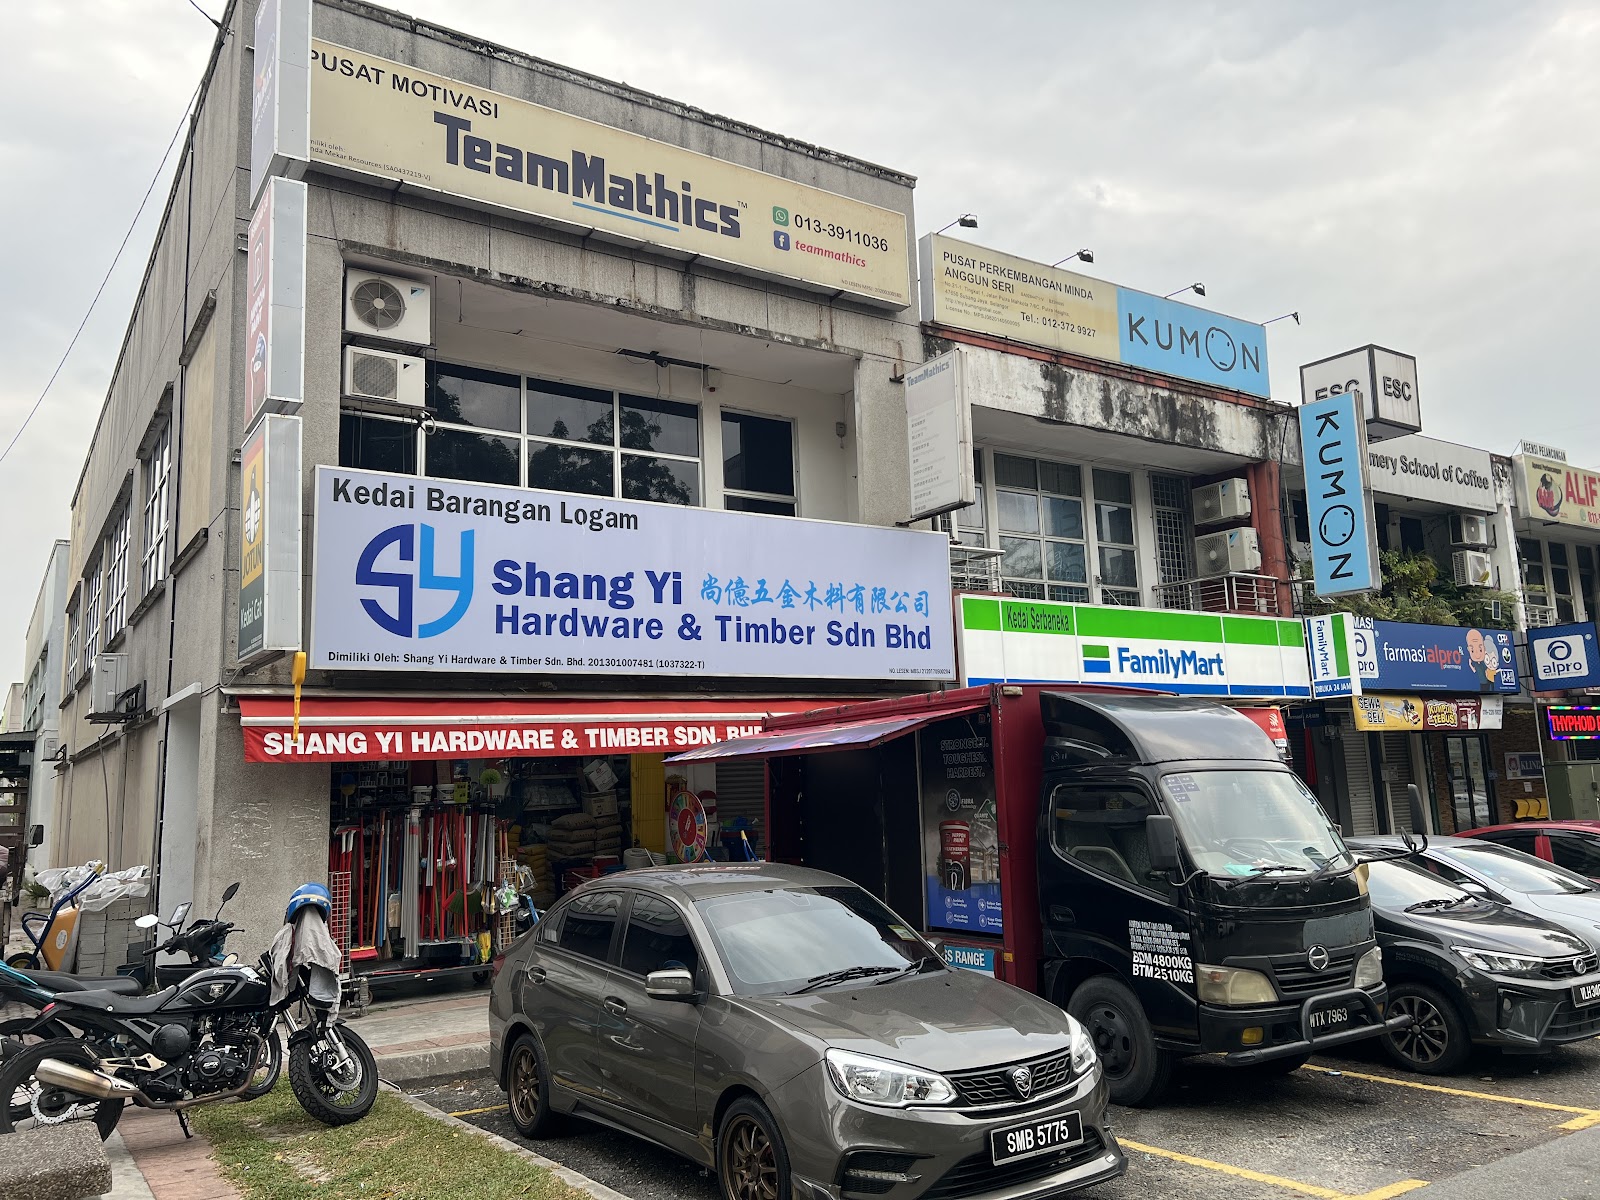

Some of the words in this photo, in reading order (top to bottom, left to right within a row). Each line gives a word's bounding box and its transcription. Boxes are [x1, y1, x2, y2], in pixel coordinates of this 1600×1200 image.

[391, 74, 499, 119] MOTIVASI
[325, 149, 347, 160] Mekar
[348, 155, 382, 169] Resources
[433, 110, 741, 239] TeamMathics
[794, 213, 889, 253] 013-3911036
[794, 239, 867, 268] teammathics
[943, 251, 977, 270] PUSAT
[979, 261, 1063, 293] PERKEMBANGAN
[1064, 284, 1094, 301] MINDA
[944, 266, 990, 289] ANGGUN
[991, 279, 1015, 295] SERI
[945, 304, 963, 314] License
[959, 292, 977, 303] Subang
[1020, 311, 1039, 325] Tel.:
[1041, 316, 1076, 333] 012-372
[1077, 325, 1097, 338] 9927
[1128, 312, 1260, 373] KUMON
[906, 360, 950, 388] TeamMathics
[1383, 376, 1412, 402] ESC
[1523, 441, 1539, 455] AGENSI
[1538, 445, 1567, 462] PELANCONGAN
[1368, 452, 1398, 476] mery
[1399, 454, 1441, 480] School
[1442, 465, 1454, 483] of
[1455, 467, 1489, 490] Coffee
[333, 477, 415, 509] Kedai
[426, 487, 551, 525] Barangan
[559, 500, 639, 532] Logam
[1315, 410, 1355, 580] KUMON
[243, 541, 263, 580] JOTUN
[491, 559, 635, 610] Shang
[644, 569, 682, 605] Yi
[700, 572, 930, 619] 尚億五金木料有限公司
[253, 597, 263, 621] Cat
[1006, 606, 1029, 629] Kedai
[1030, 607, 1070, 632] Serbaneka
[494, 604, 664, 640] Hardware
[677, 613, 702, 641] &
[715, 615, 816, 646] Timber
[826, 620, 876, 648] Sdn
[885, 623, 931, 650] Bhd
[1353, 617, 1374, 630] MASI
[328, 651, 370, 663] Dimiliki
[373, 653, 400, 664] Oleh:
[403, 653, 435, 666] Shang
[437, 654, 449, 665] Yi
[450, 654, 496, 666] Hardware
[499, 655, 508, 666] &
[510, 655, 541, 667] Timber
[544, 656, 565, 667] Sdn.
[566, 657, 586, 668] Bhd.
[588, 657, 654, 669] 201301007481
[655, 658, 705, 670] (1037322-T)
[1315, 619, 1330, 677] FamilyMart
[1383, 641, 1427, 663] farmasi
[1427, 644, 1462, 671] alpro
[1117, 647, 1225, 679] FamilyMart
[1358, 660, 1375, 675] pro
[1543, 661, 1582, 676] alpro
[1333, 683, 1341, 692] 24
[1340, 682, 1352, 691] JAM
[1358, 696, 1381, 711] SEWA
[1550, 715, 1596, 732] THYPHOID
[263, 731, 368, 756] SHANG
[374, 731, 404, 754] YI
[410, 729, 555, 753] HARDWARE
[560, 728, 579, 750] &
[584, 726, 669, 748] TIMBER
[674, 725, 722, 746] SDN.
[940, 736, 989, 752] STRONGEST.
[943, 752, 988, 765] TOUGHEST.
[947, 766, 986, 779] HARDEST.
[955, 950, 986, 967] RANGE
[1132, 950, 1153, 965] BDM
[1152, 954, 1193, 970] 4800KG
[1132, 963, 1154, 978] BTM
[1153, 966, 1194, 984] 2510KG
[1326, 1007, 1348, 1024] 7963
[1006, 1131, 1034, 1154] SMB
[1037, 1119, 1069, 1144] 5775
